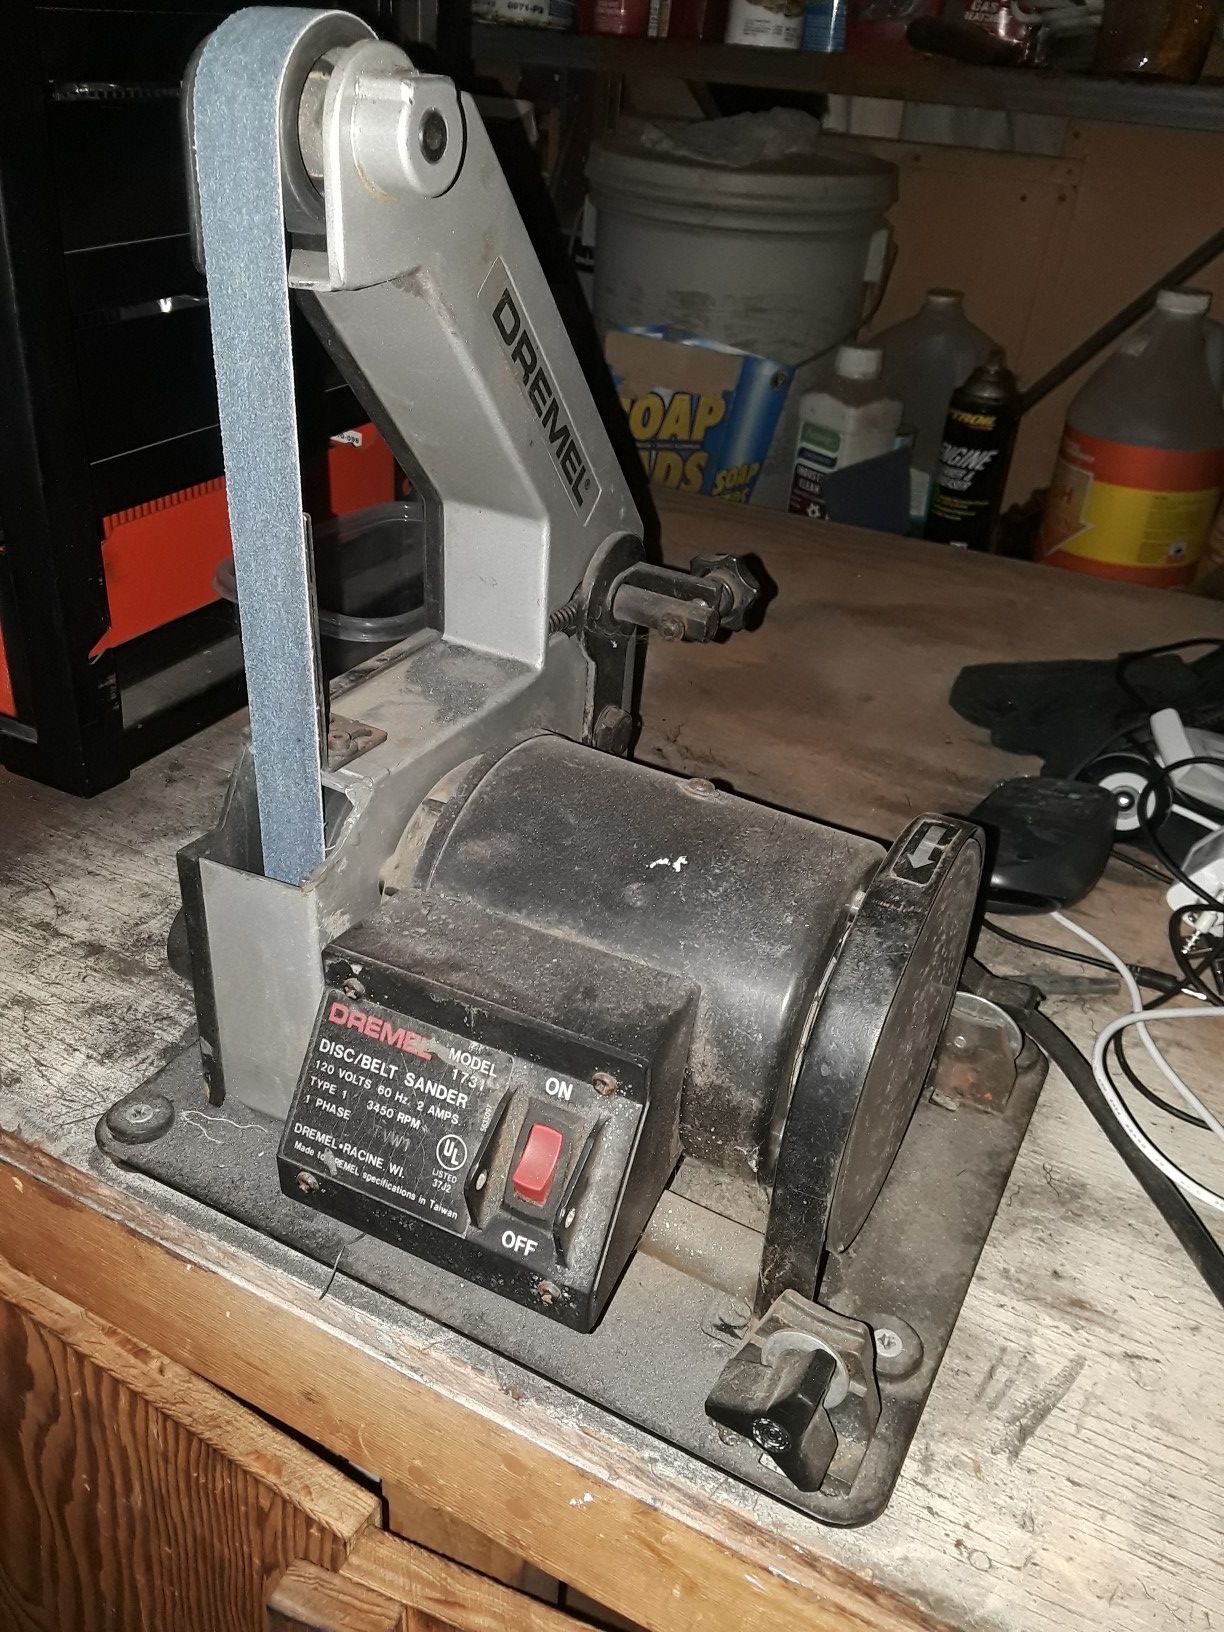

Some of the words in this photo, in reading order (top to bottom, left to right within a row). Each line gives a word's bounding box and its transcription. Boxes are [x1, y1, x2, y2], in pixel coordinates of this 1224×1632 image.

[492, 287, 586, 507] DREMEL
[640, 449, 710, 494] DS
[328, 1001, 432, 1061] DREMEL
[319, 1038, 399, 1080] DISC/BELT
[404, 1072, 469, 1109] SANDER
[448, 1047, 497, 1078] MODEL
[309, 1075, 338, 1095] TYPE
[341, 1089, 348, 1099] 1
[314, 1059, 335, 1075] 120
[338, 1067, 373, 1090] VOLTS
[377, 1084, 393, 1098] 60
[416, 1100, 425, 1112] 2
[545, 1076, 574, 1101] ON
[304, 1094, 311, 1104] 1
[315, 1097, 352, 1121] PHASE
[366, 1100, 395, 1119] 3450
[396, 1111, 422, 1130] RPM
[293, 1140, 315, 1157] Made
[326, 1152, 360, 1177] REMEL
[361, 1171, 416, 1206] specifications
[418, 1192, 427, 1206] in
[429, 1199, 459, 1220] Taiwan
[389, 1162, 405, 1179] WI.
[431, 1166, 459, 1185] LISTED
[431, 1179, 454, 1194] 37J2
[501, 1230, 539, 1257] OFF
